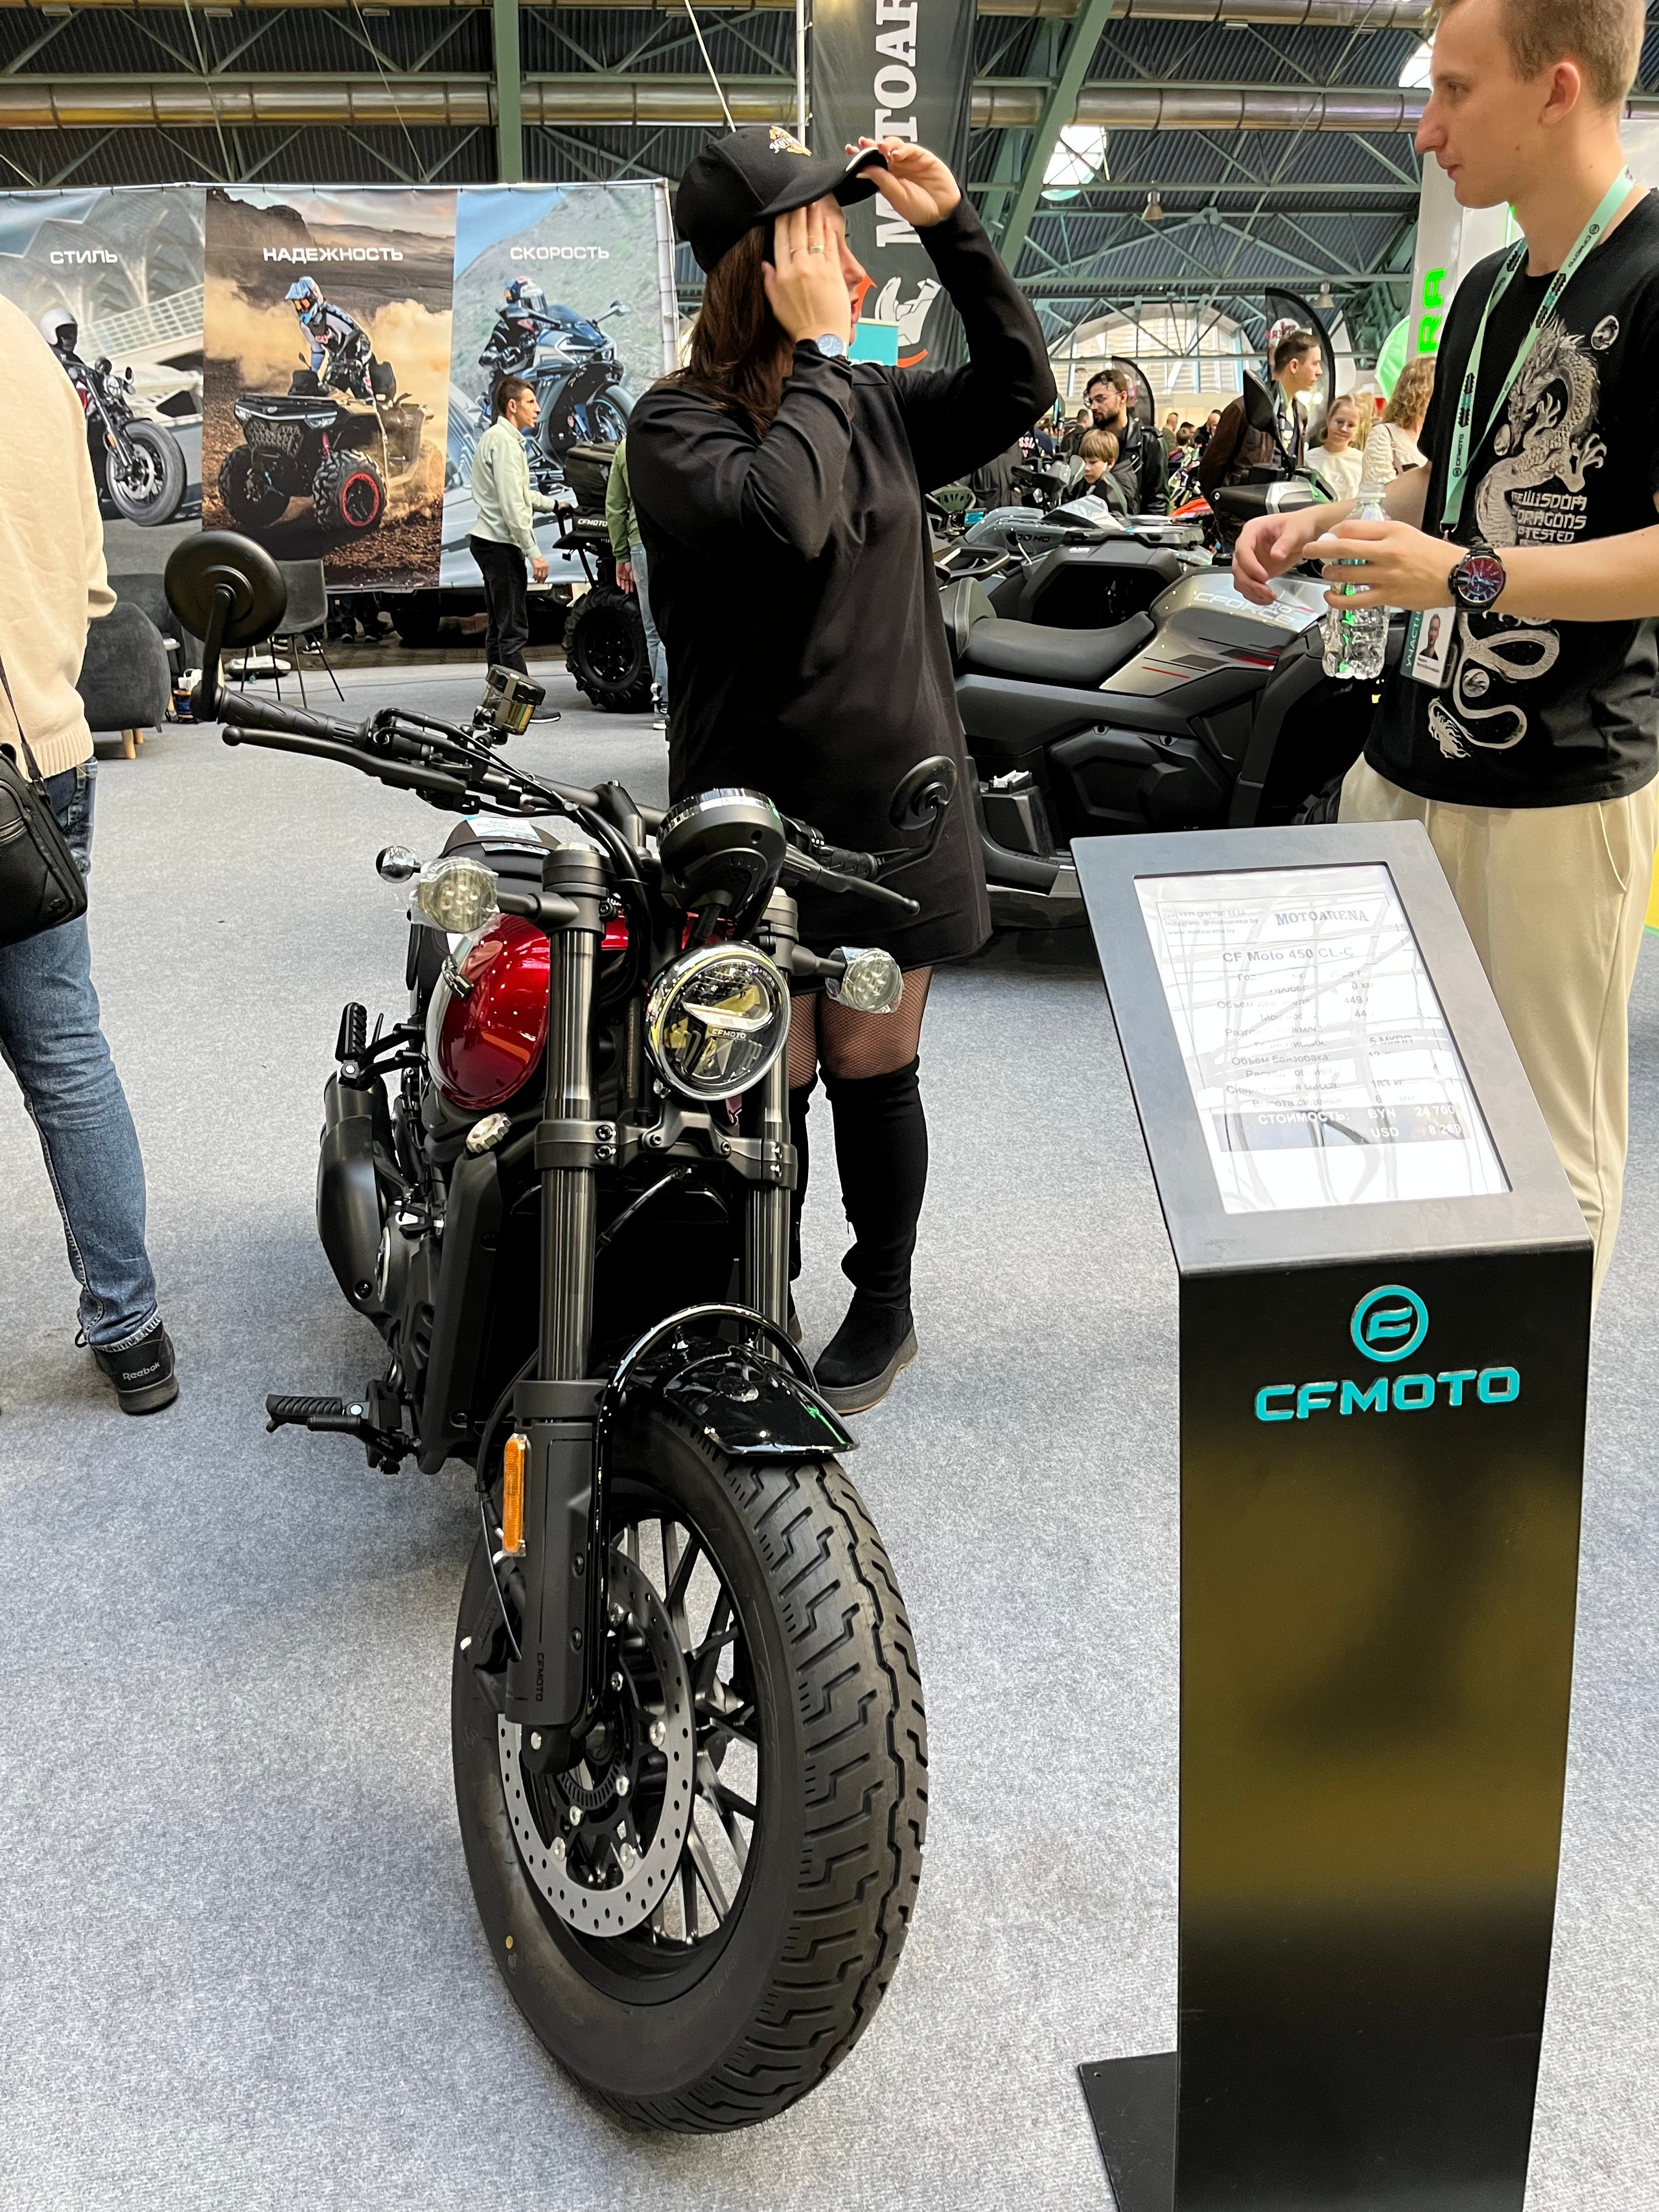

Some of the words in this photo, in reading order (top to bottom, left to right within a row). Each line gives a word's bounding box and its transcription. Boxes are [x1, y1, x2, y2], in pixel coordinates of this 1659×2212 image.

[874, 0, 922, 248] MTOAR
[50, 250, 118, 264] СТИЛЬ
[262, 247, 404, 264] НАДЕЖНОСТЬ
[510, 246, 610, 260] СКОРОСТЬ
[577, 518, 608, 527] CFMOTO
[1193, 592, 1295, 626] CFORCE
[1274, 909, 1369, 926] MOTOARENA
[1222, 951, 1242, 962] CF
[1247, 950, 1284, 962] Moto
[1289, 949, 1314, 959] 450
[1317, 947, 1354, 958] CL-C
[712, 1028, 747, 1040] CFMOTO
[1257, 1111, 1350, 1125] СТОИМОСТЬ:
[1367, 1108, 1397, 1120] BYN
[1414, 1106, 1431, 1117] 24
[1432, 1104, 1456, 1115] 700
[1371, 1126, 1400, 1138] USD
[1428, 1124, 1436, 1135] 8
[122, 1362, 161, 1381] Reebok
[1254, 1366, 1521, 1422] CFMOTO
[535, 1652, 544, 1702] CFMOTO
